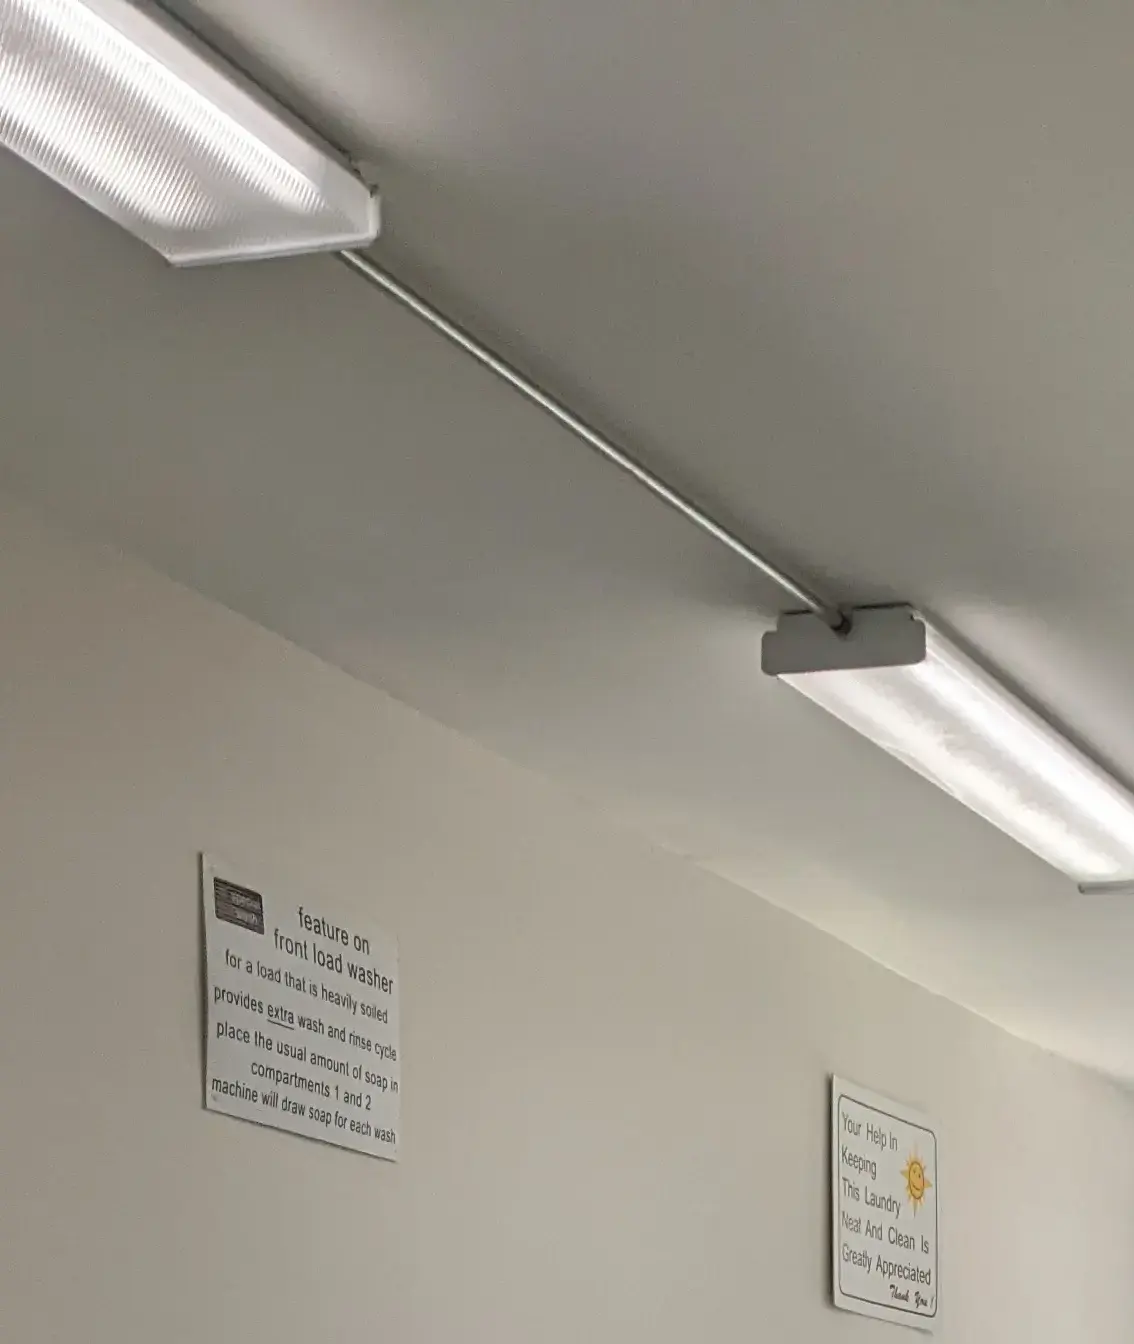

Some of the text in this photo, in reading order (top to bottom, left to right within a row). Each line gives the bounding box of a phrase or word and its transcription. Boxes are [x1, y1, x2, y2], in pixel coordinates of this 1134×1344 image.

[299, 907, 348, 946] feature
[354, 932, 369, 955] on
[274, 929, 393, 995] front load washer
[226, 949, 387, 1024] for a load that is heavily soiled
[214, 984, 396, 1061] provides extra wash and rinse cycle
[217, 1021, 398, 1093] place the usual amount of soap in
[212, 1076, 395, 1144] machine will draw soap for each wash
[251, 1062, 371, 1111] compartments 1 and 2
[842, 1111, 897, 1151] Your Help In
[842, 1146, 876, 1180] Keeping
[842, 1176, 900, 1219] This Laundry
[842, 1211, 929, 1254] Neat And Clean Is
[842, 1243, 931, 1285] Greatly Appreciated
